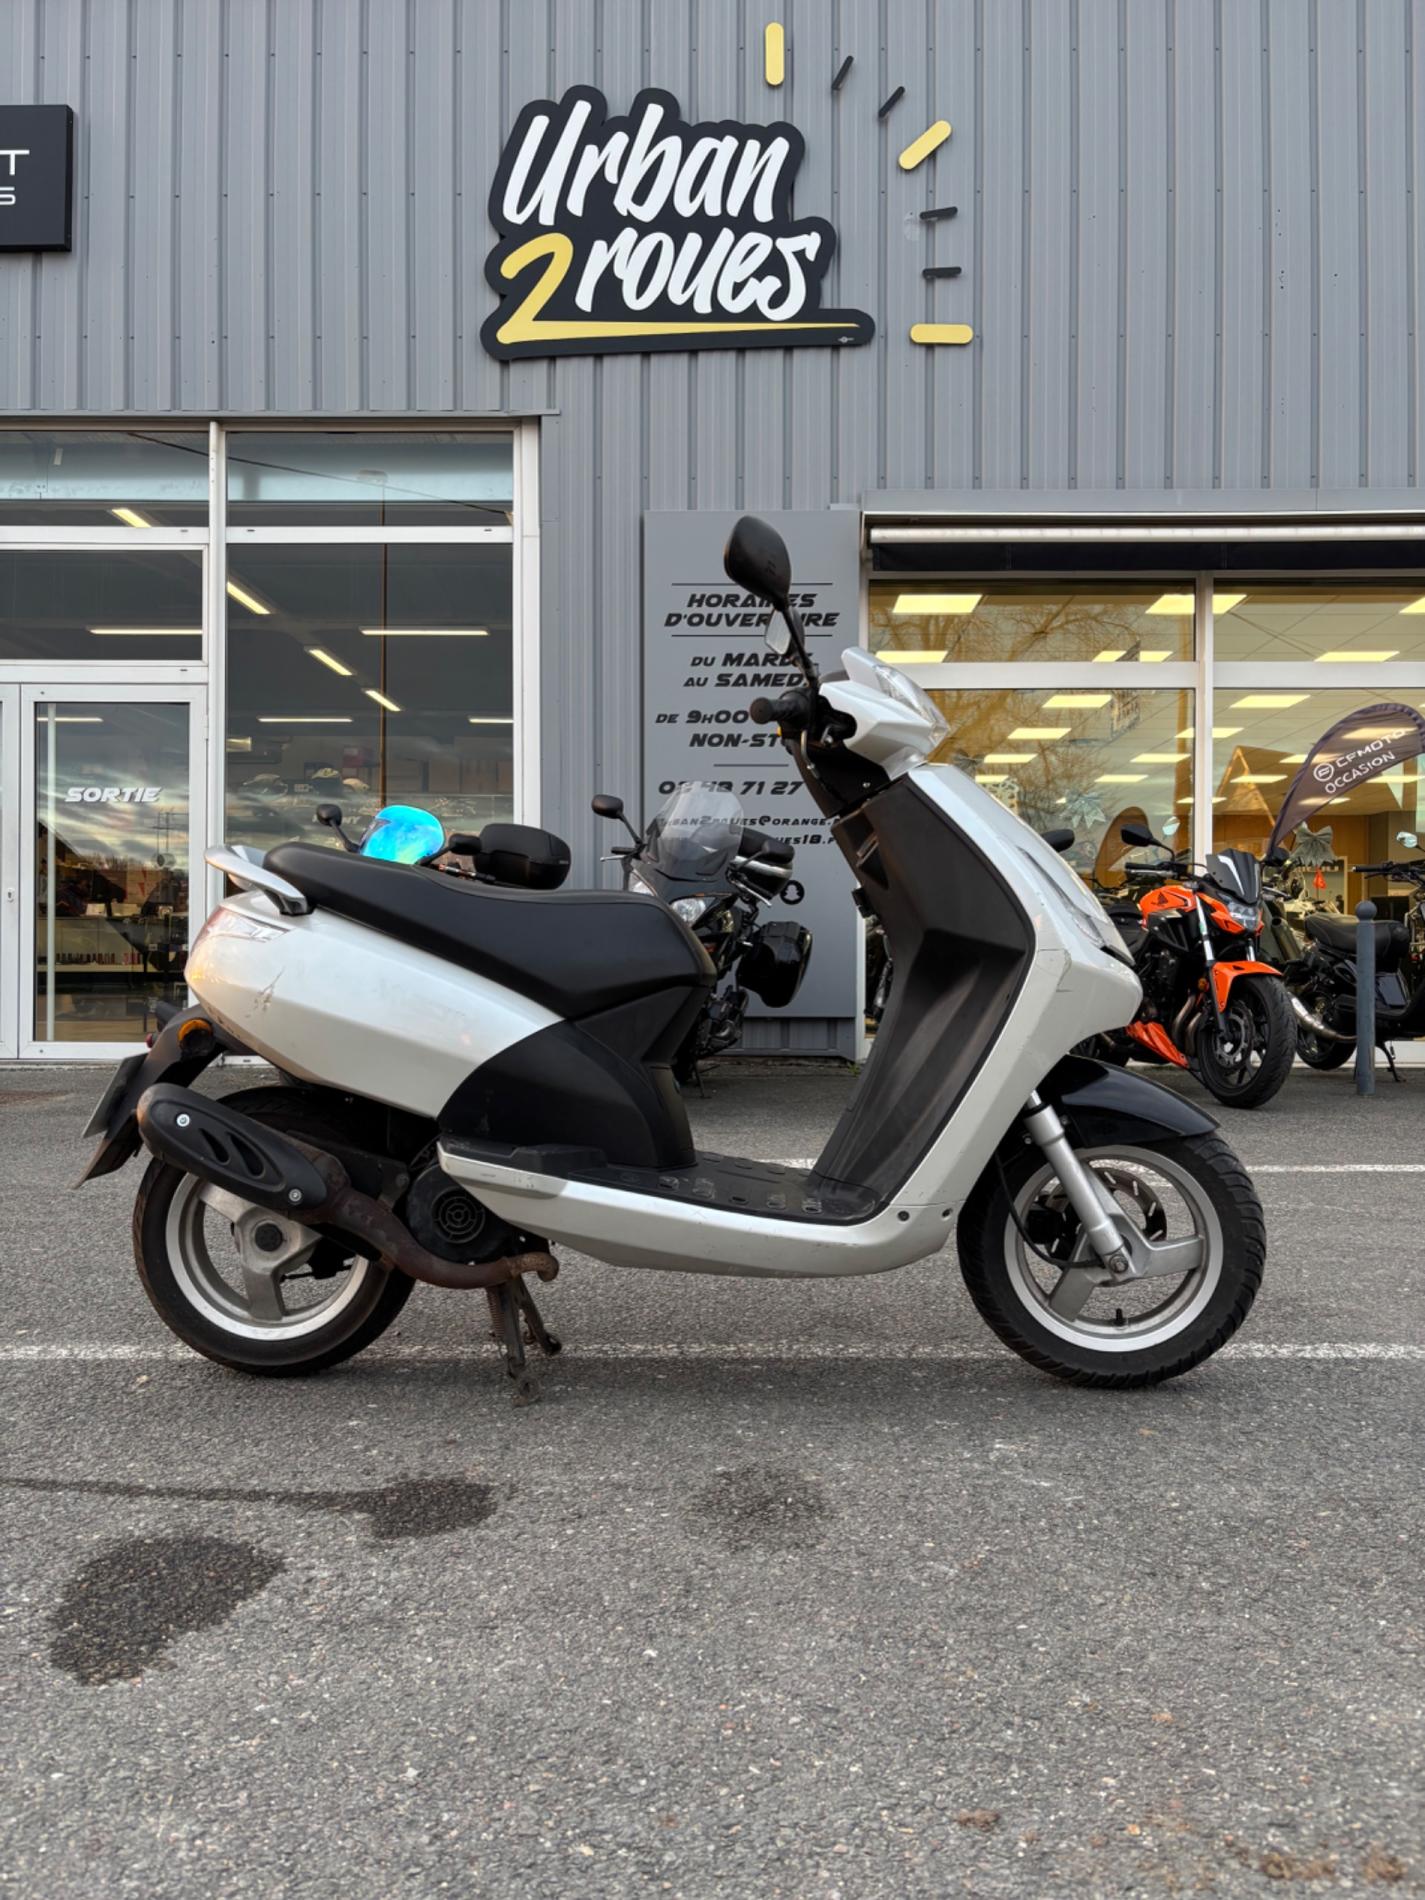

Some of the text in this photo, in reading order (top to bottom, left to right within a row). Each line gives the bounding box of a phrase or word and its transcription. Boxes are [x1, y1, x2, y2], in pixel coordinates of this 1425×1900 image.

[503, 100, 790, 226] Urban
[687, 593, 817, 608] HORAIES
[664, 612, 840, 627] D'OUVERRE
[690, 653, 812, 667] DU MARD
[684, 673, 809, 687] AU SAMED
[655, 713, 679, 724] DE
[689, 733, 786, 748] NON-ST
[1324, 750, 1396, 794] OCCASION
[65, 786, 162, 803] SORTIE
[740, 781, 766, 795] 71
[770, 781, 803, 795] 27
